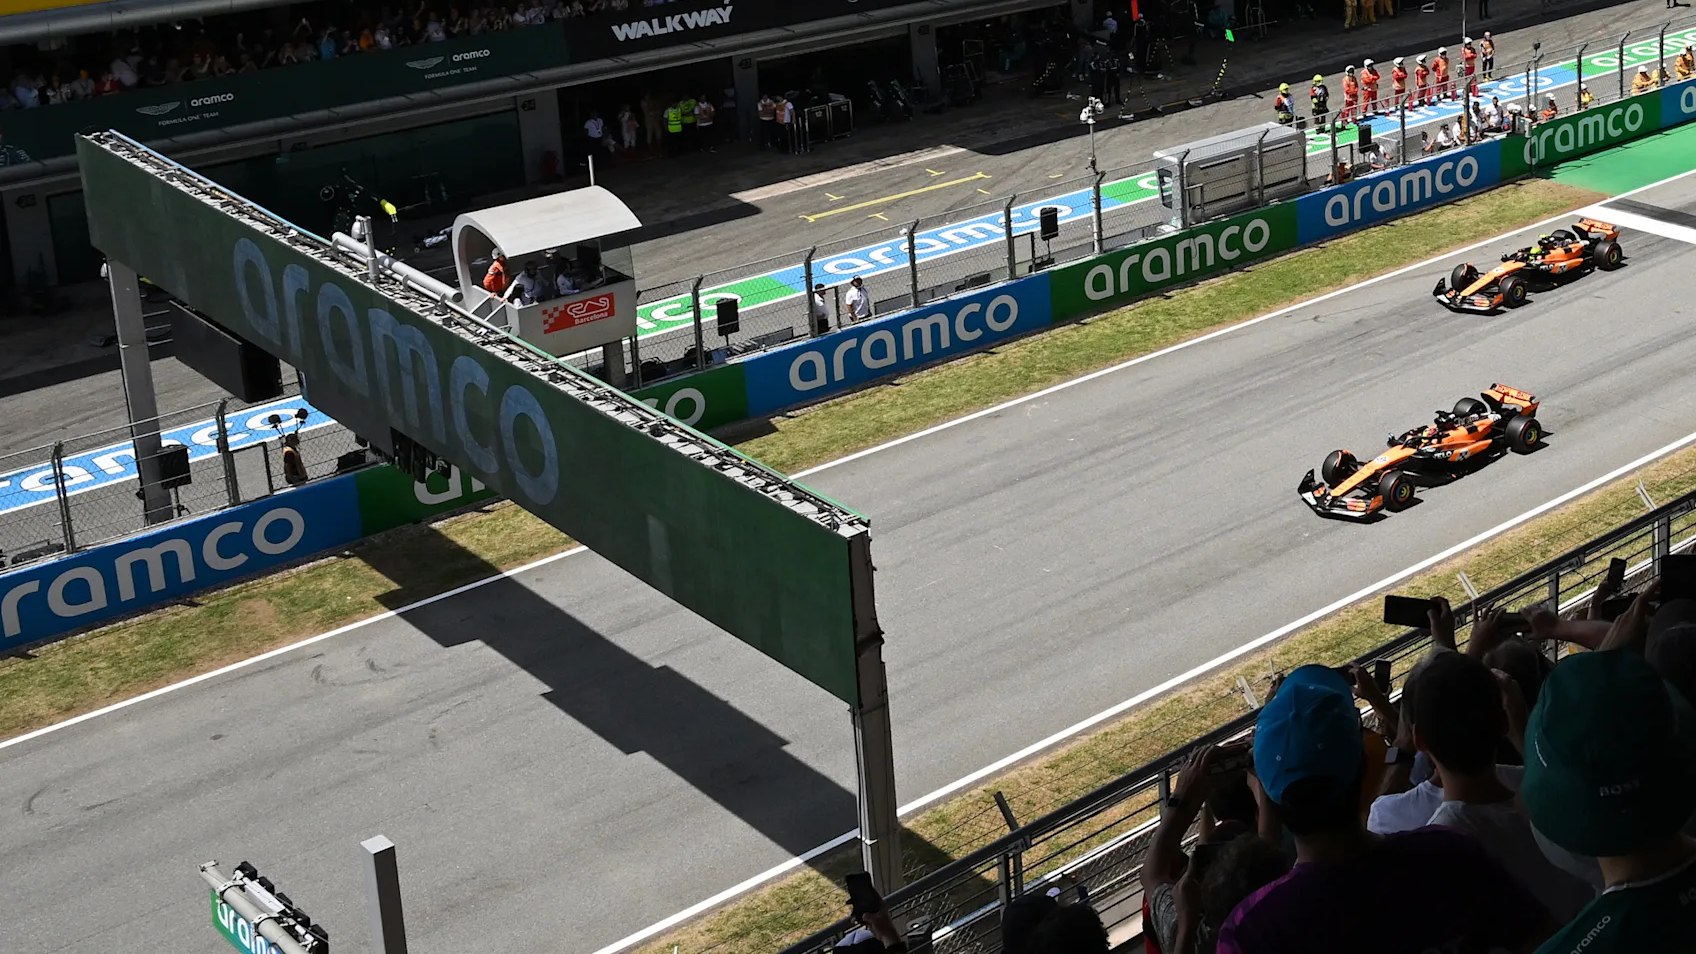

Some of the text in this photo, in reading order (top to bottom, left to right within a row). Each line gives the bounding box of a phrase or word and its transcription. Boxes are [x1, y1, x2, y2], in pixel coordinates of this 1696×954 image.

[611, 5, 733, 42] WALKWAY
[424, 71, 450, 80] FORMULA
[463, 66, 477, 74] TEAM
[452, 49, 490, 62] aramco
[191, 92, 234, 107] aramco
[158, 116, 187, 127] FORMULA
[202, 111, 219, 119] TEAM
[1523, 102, 1644, 166] aramco
[1324, 155, 1479, 227] aramco
[822, 204, 1073, 275] aramco
[1084, 218, 1271, 300] aramco
[575, 311, 608, 324] Barcelona
[788, 294, 1019, 391] aramco
[233, 237, 559, 505] aramco
[1599, 779, 1640, 796] BOSS
